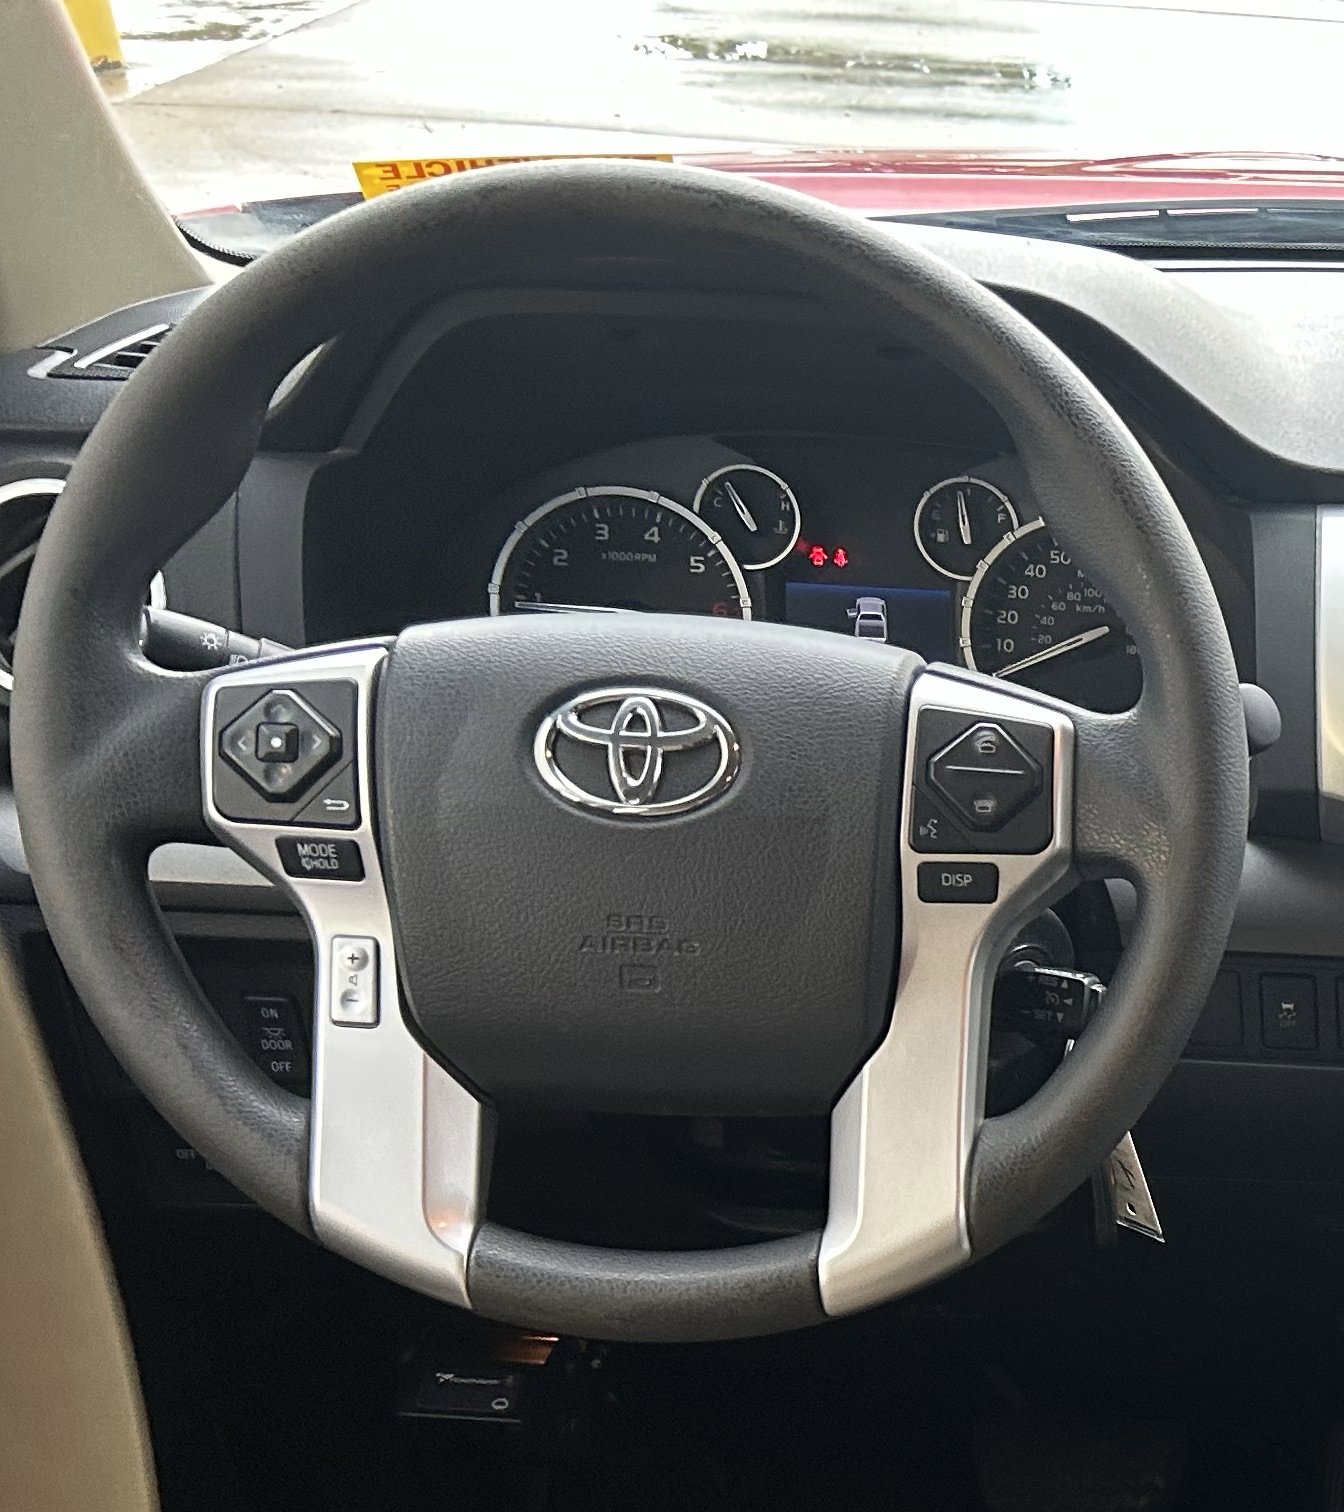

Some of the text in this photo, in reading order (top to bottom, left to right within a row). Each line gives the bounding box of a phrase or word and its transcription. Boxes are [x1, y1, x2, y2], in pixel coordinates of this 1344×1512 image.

[595, 523, 609, 541] 3
[643, 526, 661, 544] 4
[553, 549, 569, 566] 2
[1049, 550, 1072, 565] 50
[689, 556, 706, 574] 5
[1024, 563, 1047, 578] 40
[1007, 585, 1029, 599] 30
[1066, 591, 1082, 602] 80
[1051, 601, 1066, 612] 60
[1075, 603, 1106, 614] km/h
[996, 610, 1019, 625] 20
[1039, 616, 1055, 626] 40
[996, 638, 1015, 653] 10
[1037, 634, 1053, 644] 20
[296, 843, 338, 858] MODE
[311, 858, 340, 870] HOLD
[941, 872, 973, 887] DISP
[261, 1008, 278, 1019] ON
[261, 1039, 293, 1050] DOOR
[271, 1061, 292, 1072] OFF
